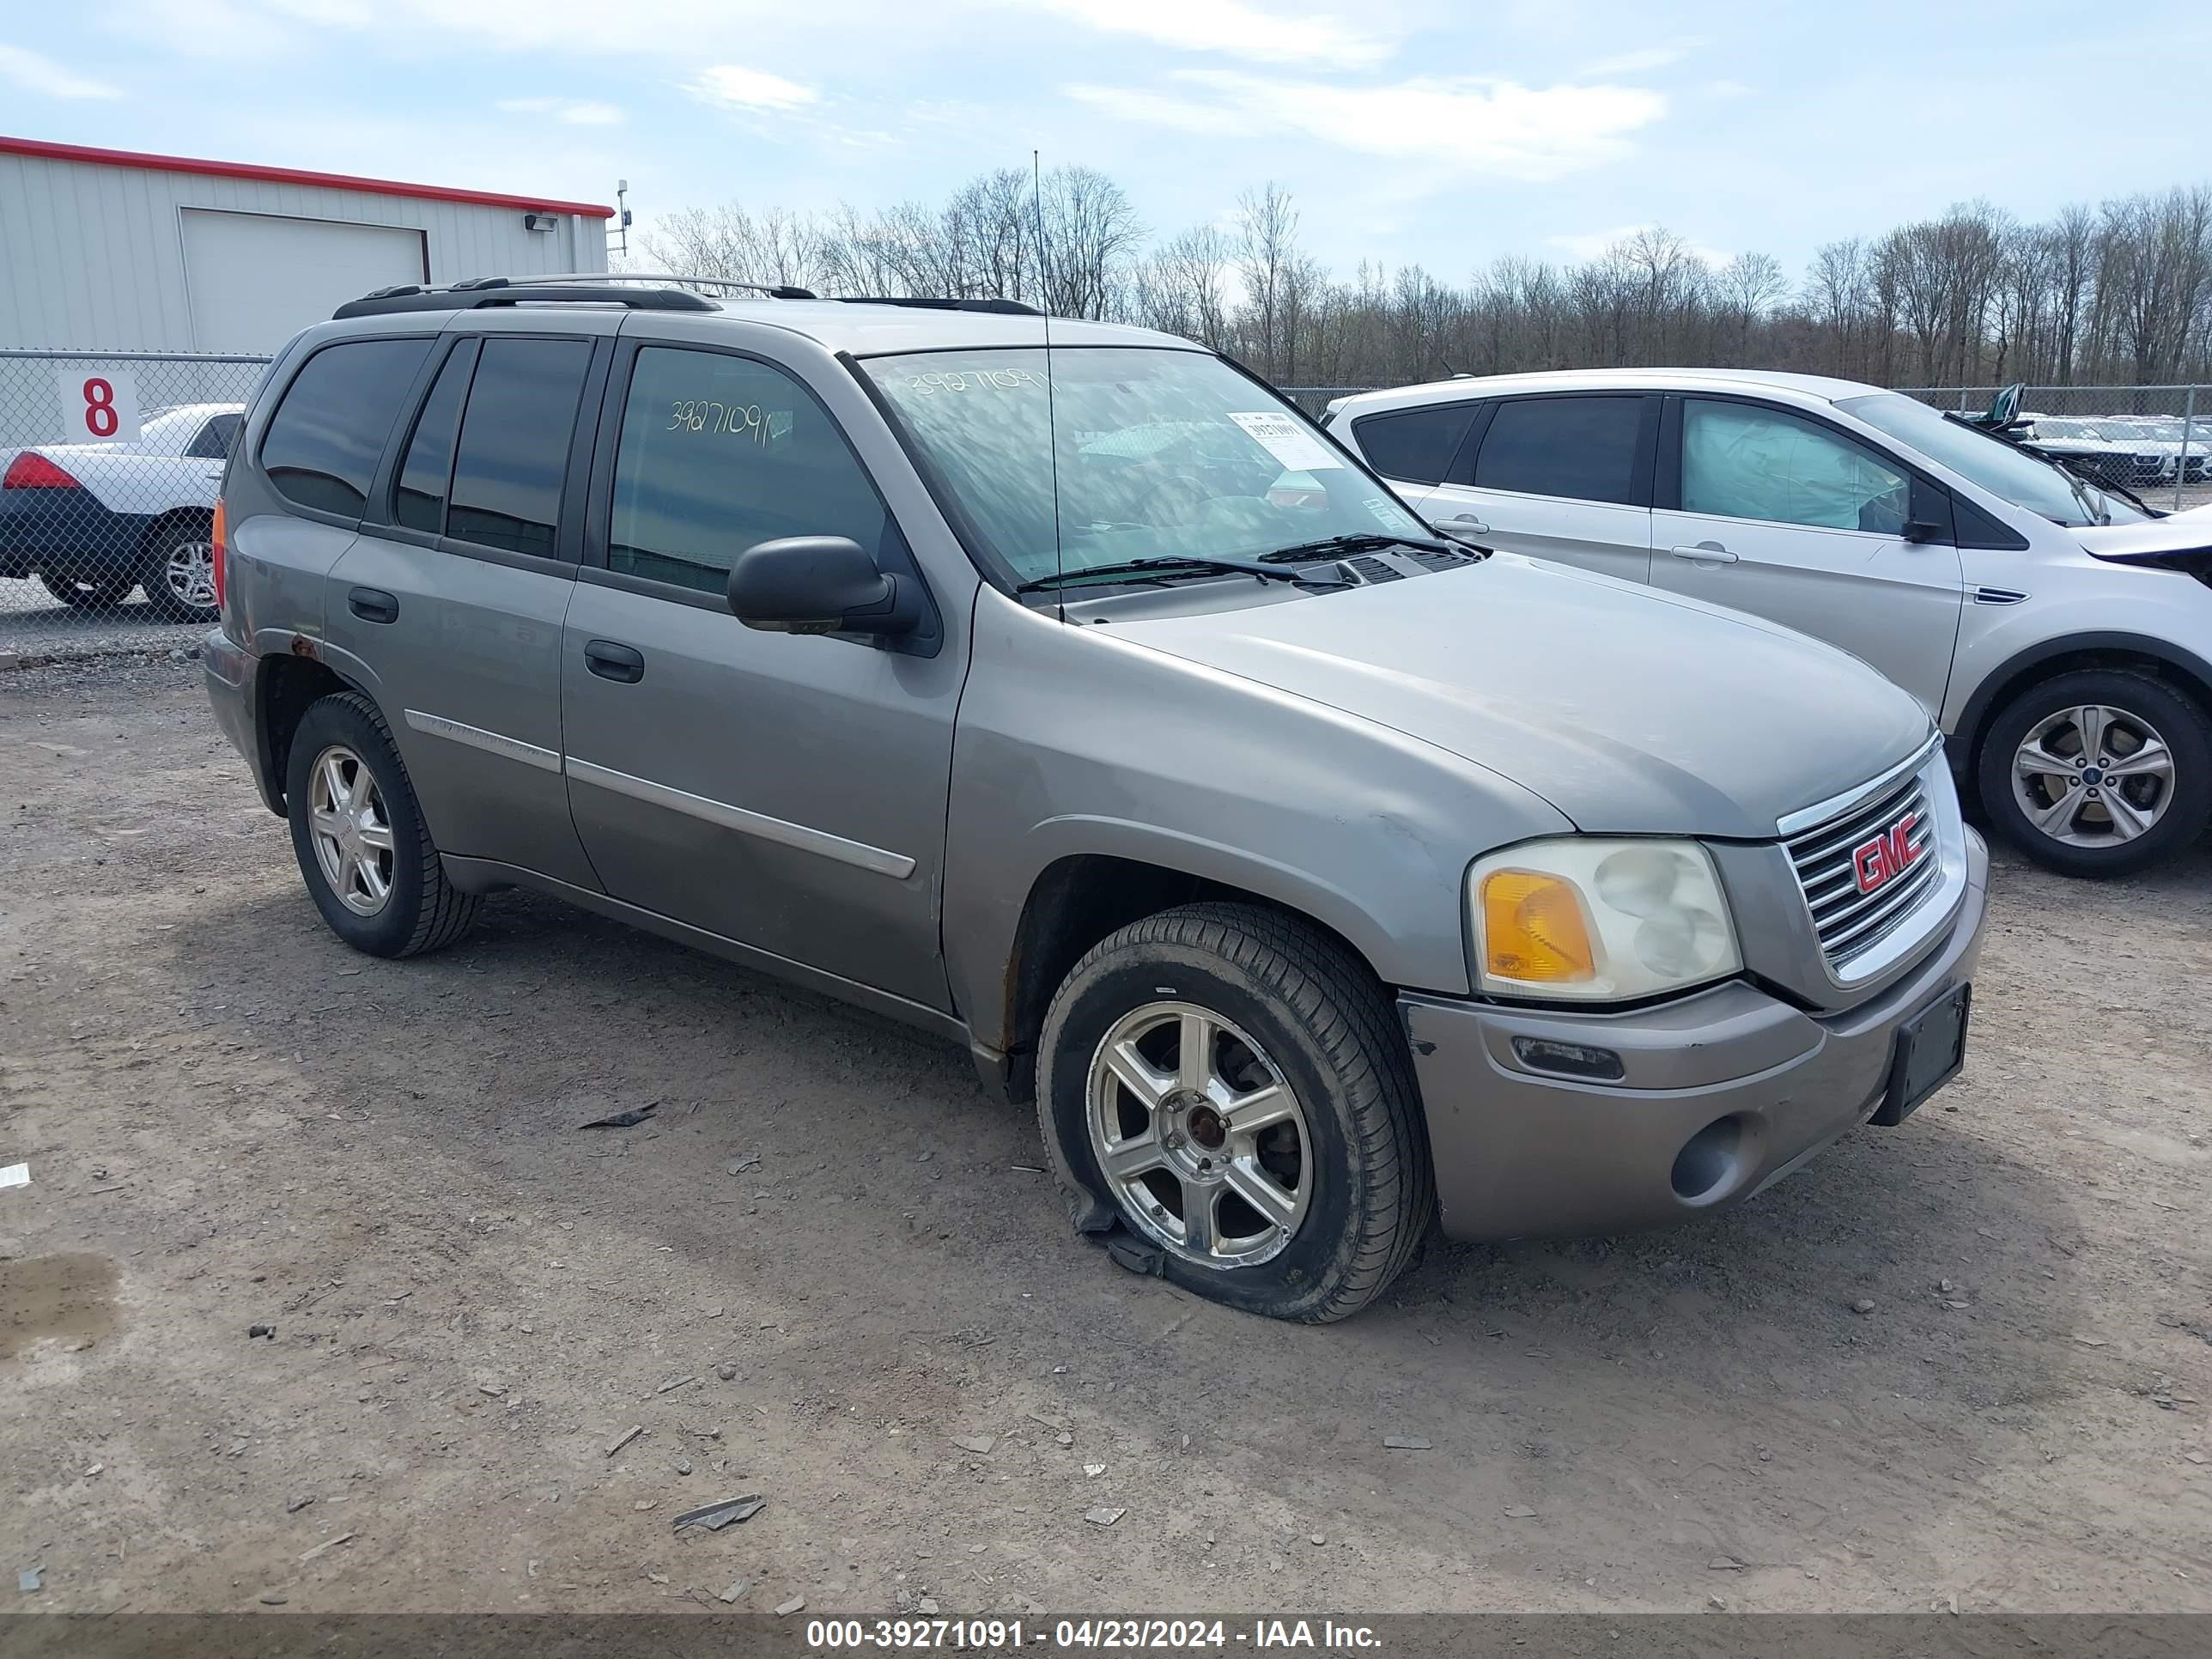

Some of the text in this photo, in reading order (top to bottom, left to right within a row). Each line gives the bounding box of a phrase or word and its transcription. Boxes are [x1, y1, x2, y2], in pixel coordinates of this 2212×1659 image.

[83, 378, 118, 437] 8
[666, 400, 771, 448] 39271091
[1853, 811, 1923, 895] GMC
